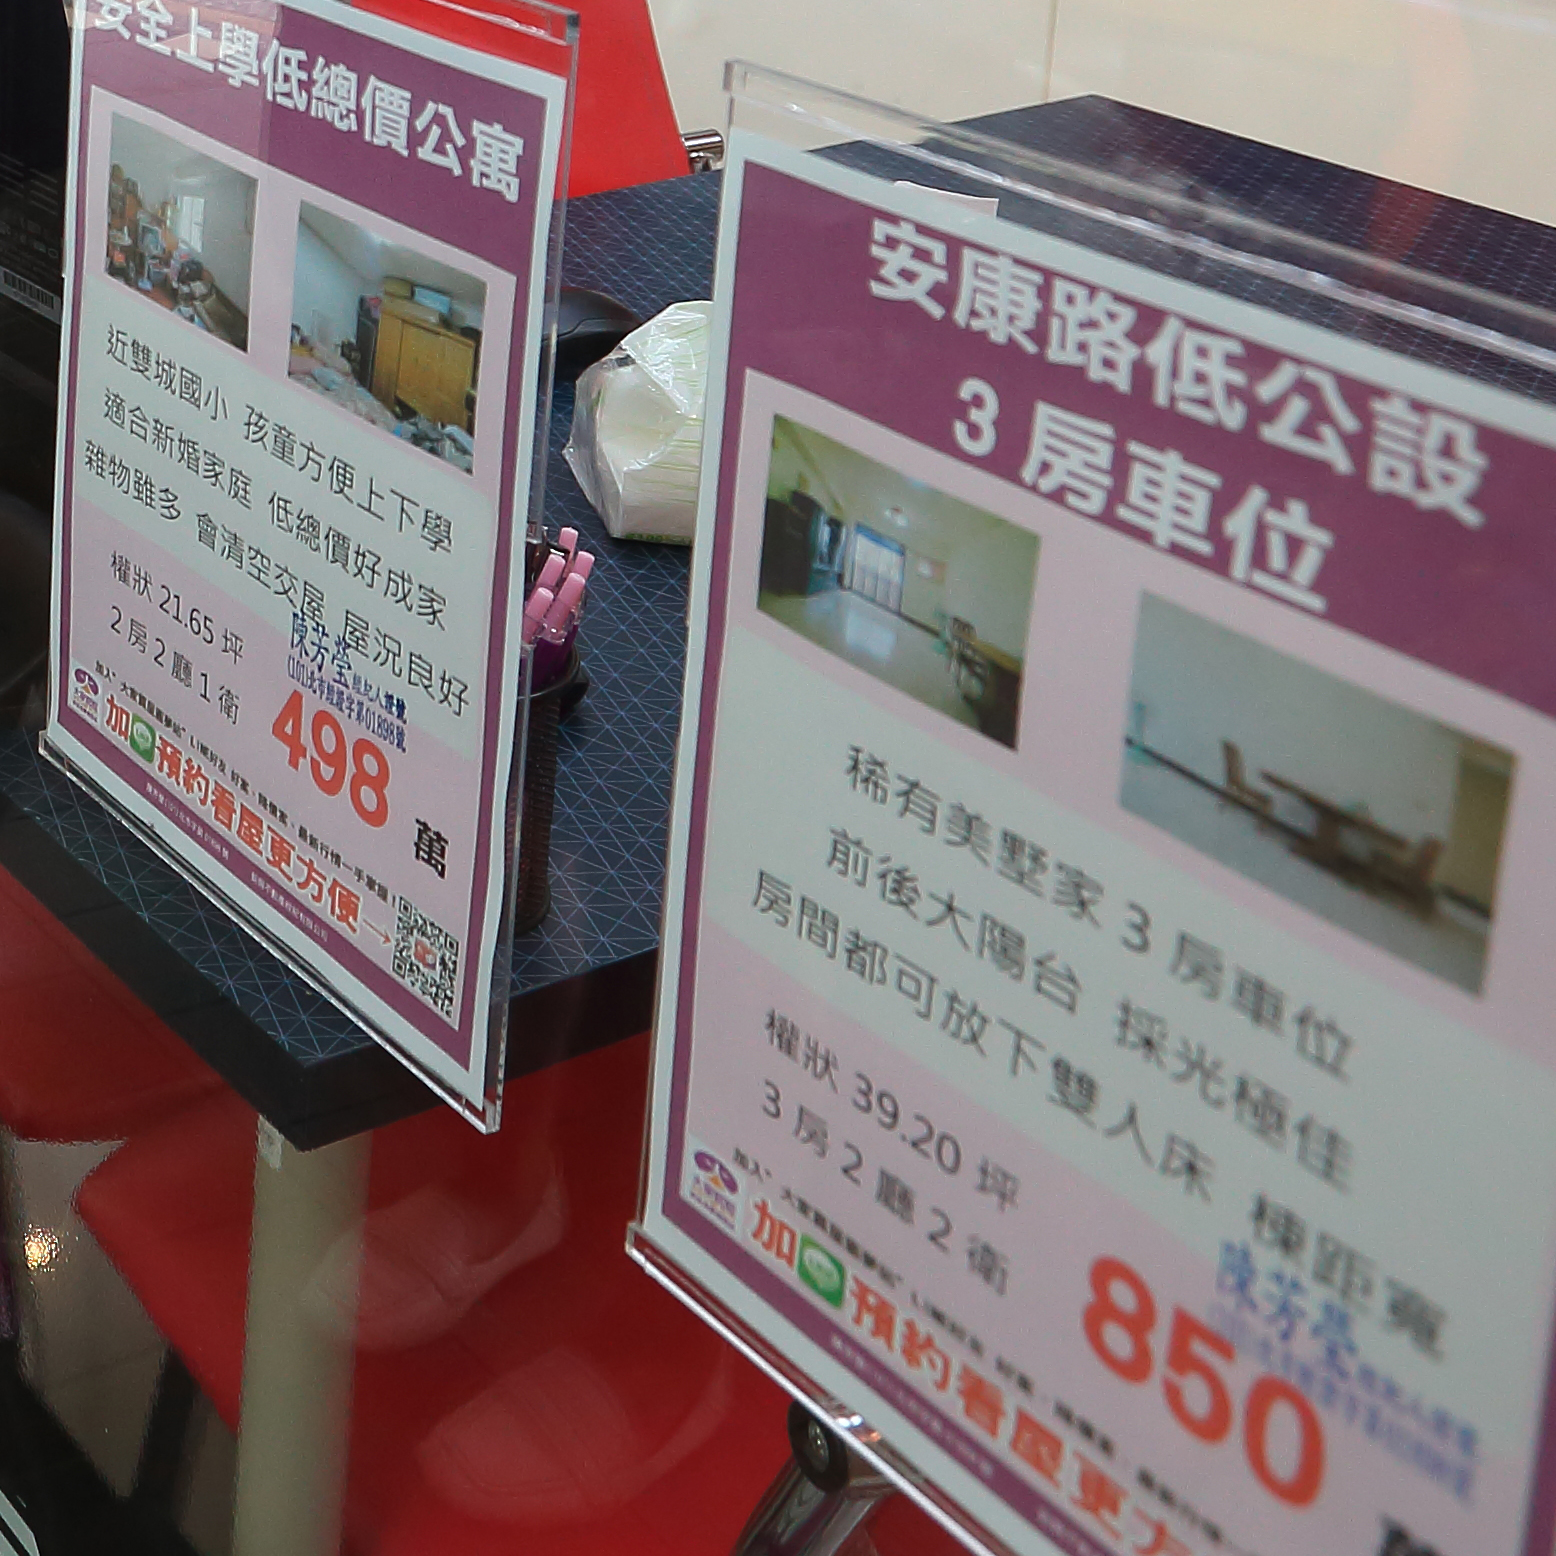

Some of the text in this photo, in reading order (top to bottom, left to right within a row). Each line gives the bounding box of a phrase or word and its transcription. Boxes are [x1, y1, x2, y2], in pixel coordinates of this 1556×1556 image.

[104, 322, 456, 555] 近雙城國小 孩童方便上下學
[867, 214, 1492, 532] 安康路低公設
[83, 437, 469, 718] 雜物雖多 會清空交屋 屋況良好
[103, 385, 448, 632] 適合新婚家庭 低總價好成家
[105, 693, 131, 742] 加
[156, 734, 362, 935] 預約看屋更方便
[270, 689, 391, 830] 498
[413, 816, 450, 881] 萬
[749, 867, 1221, 1208] 房間都可放下雙人床
[1247, 1190, 1454, 1364] 棟距寬
[824, 822, 1358, 1195] 前後大陽台 採光極佳
[1081, 1253, 1328, 1513] 850
